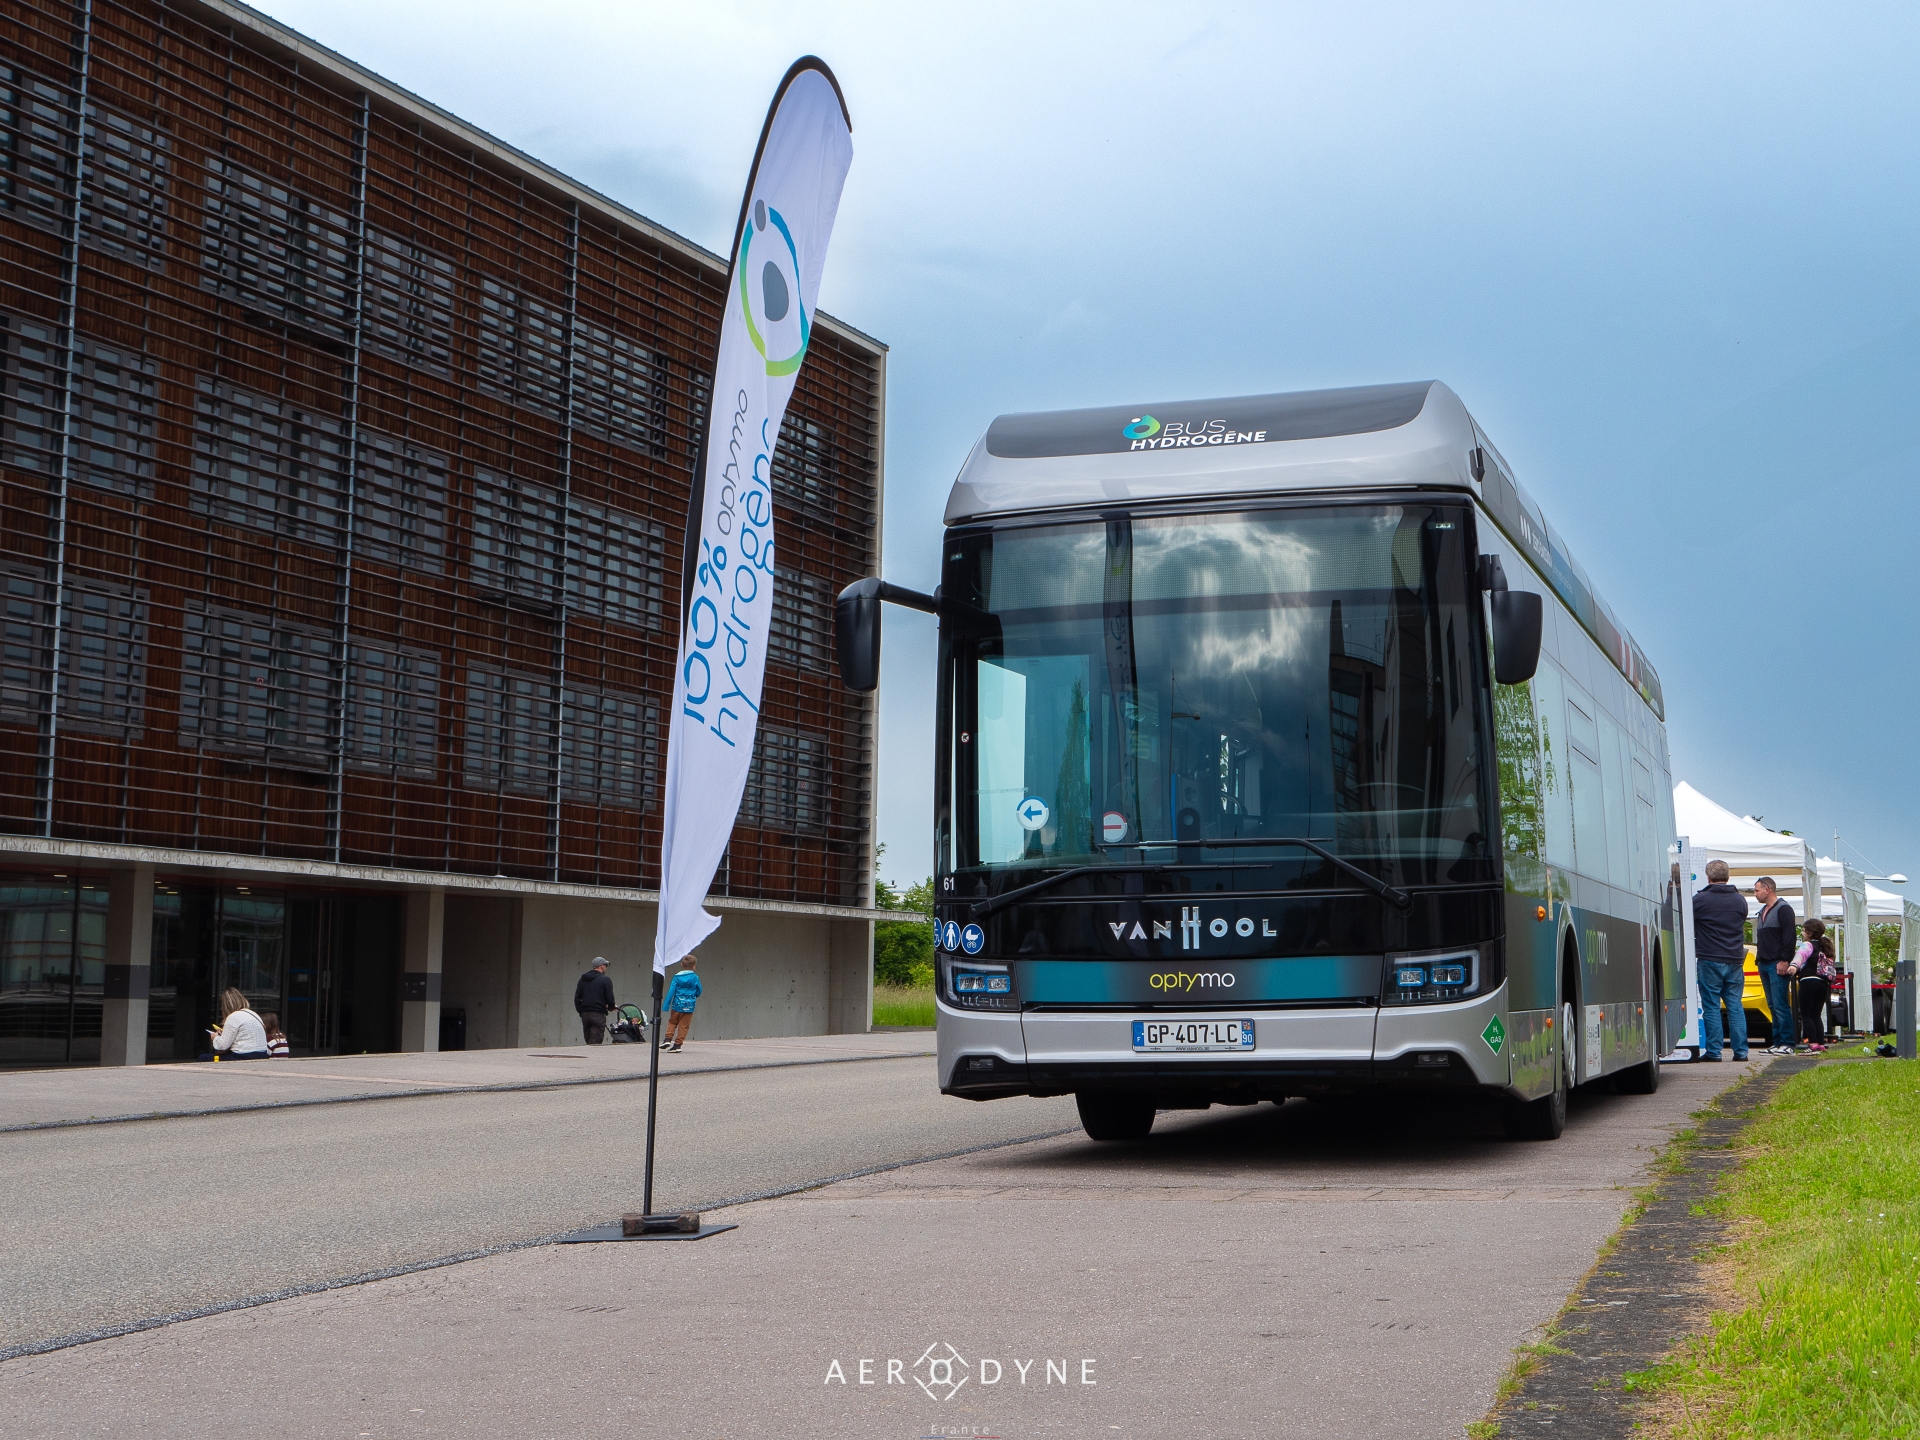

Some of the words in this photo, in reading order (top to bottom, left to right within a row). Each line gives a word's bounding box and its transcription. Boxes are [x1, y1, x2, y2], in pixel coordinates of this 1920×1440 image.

[1163, 419, 1227, 437] BUS
[717, 389, 748, 536] optymo
[684, 537, 727, 724] 100%
[944, 877, 954, 890] 61
[1150, 971, 1236, 993] optymo
[1147, 1024, 1238, 1044] GP-407-LC
[1242, 1033, 1253, 1043] 90
[1490, 1035, 1502, 1043] GAS
